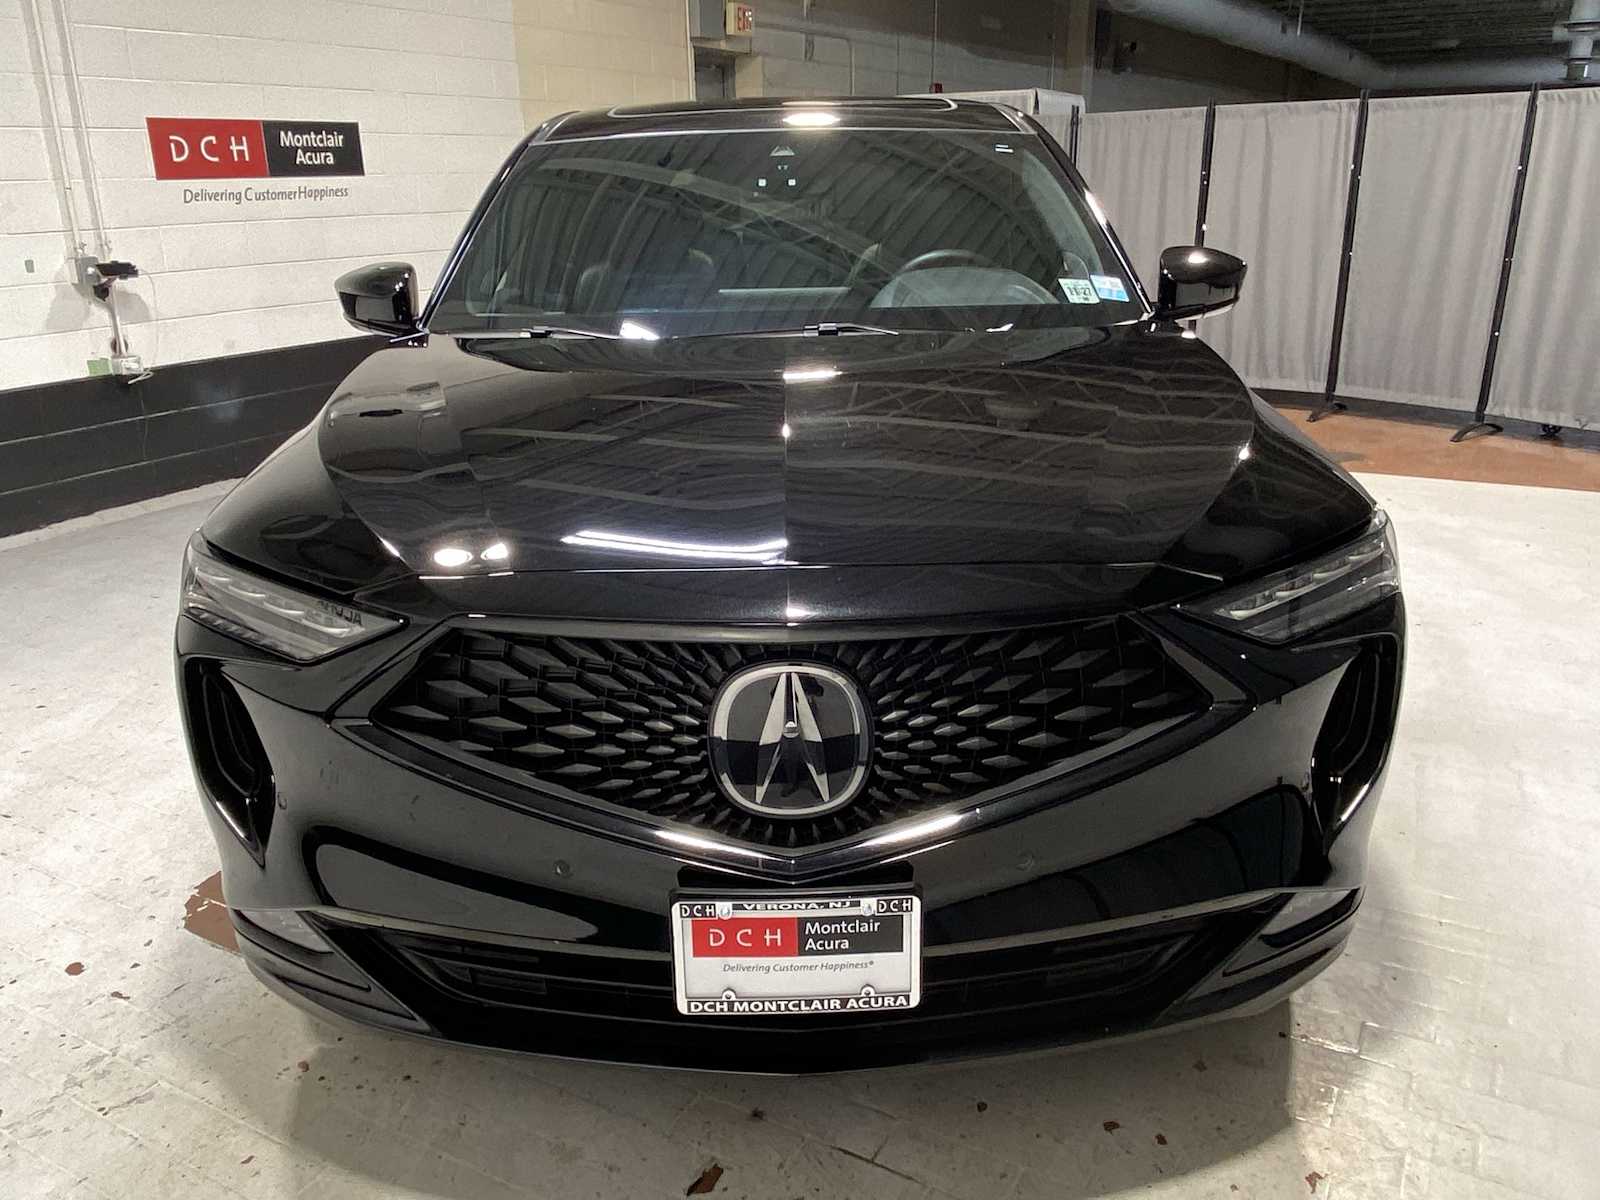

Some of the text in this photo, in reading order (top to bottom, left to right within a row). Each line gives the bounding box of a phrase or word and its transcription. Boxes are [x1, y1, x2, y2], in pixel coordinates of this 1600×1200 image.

[279, 130, 344, 148] Montclair
[169, 135, 250, 162] DCH
[296, 149, 335, 165] Acura
[183, 185, 349, 204] Delivering Customer Happiness
[681, 904, 715, 917] DCH
[829, 901, 851, 909] NJ
[879, 900, 912, 912] DCH
[805, 919, 880, 935] Montclair
[709, 928, 782, 947] DCH
[805, 938, 849, 951] Acura
[723, 963, 770, 974] Delivering
[772, 962, 818, 972] Customer
[690, 996, 908, 1013] DCH MONTCLAIR ACURA
